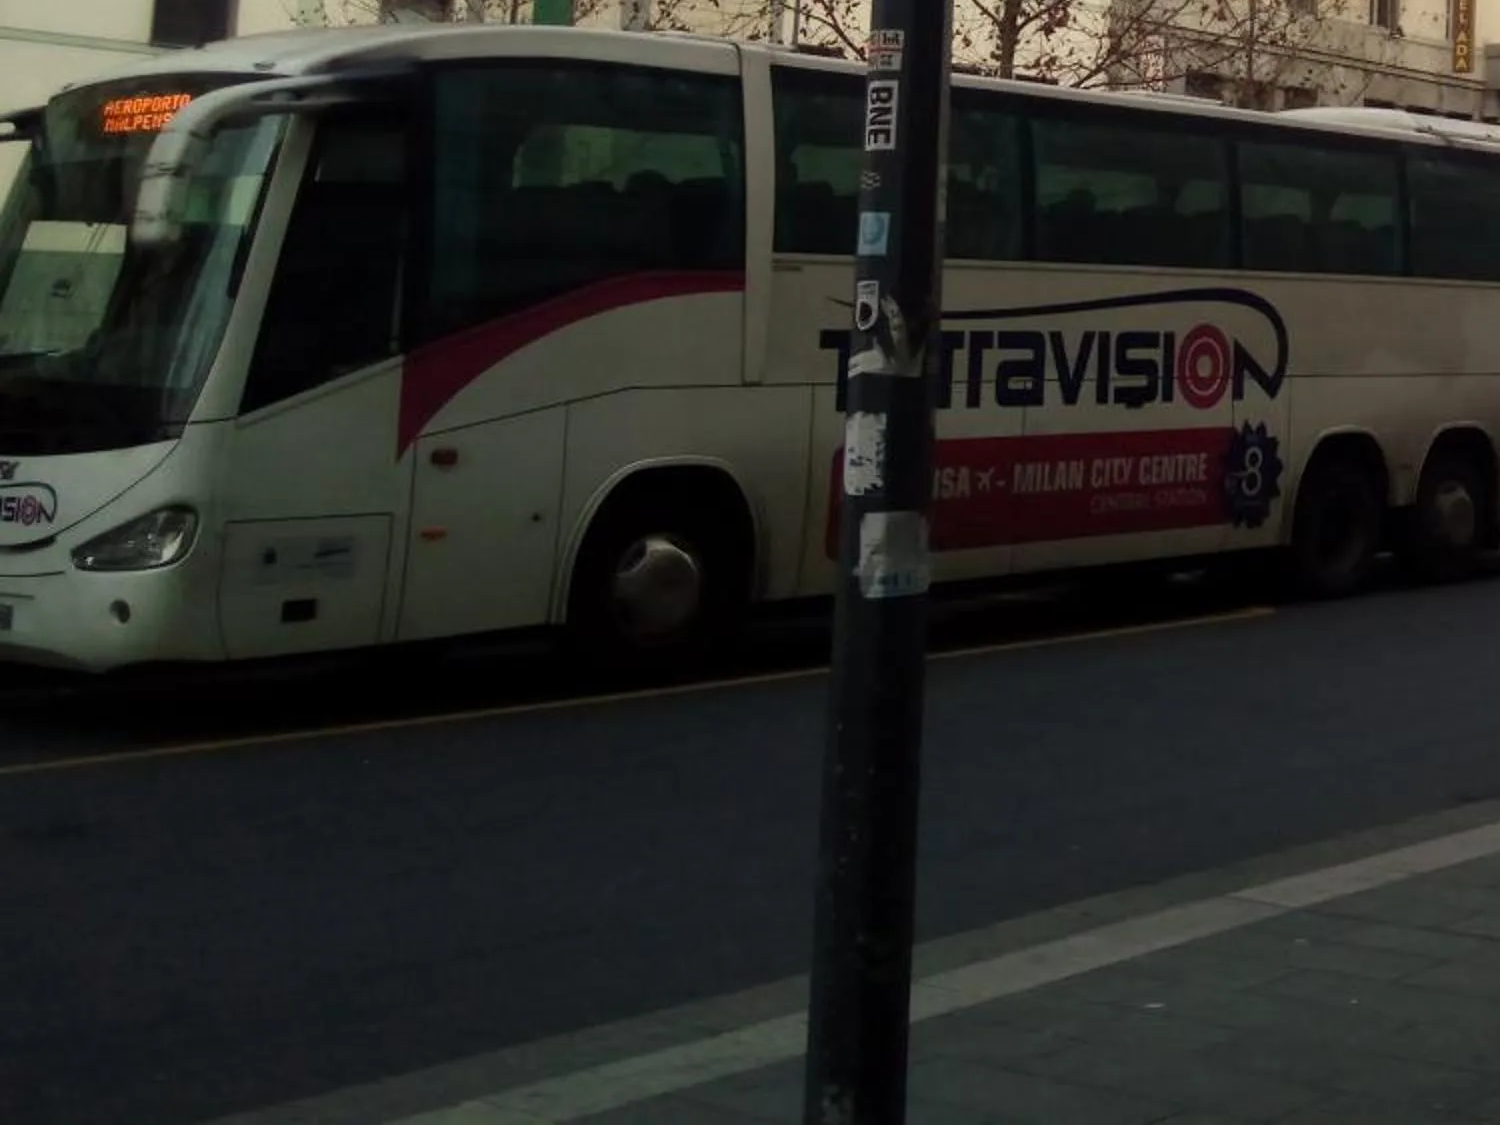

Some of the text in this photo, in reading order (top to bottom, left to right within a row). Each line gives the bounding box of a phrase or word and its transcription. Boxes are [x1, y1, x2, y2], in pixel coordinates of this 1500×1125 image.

[1456, 31, 1469, 71] ADA
[103, 94, 192, 115] AEROPORTO
[103, 112, 175, 132] MALPENS
[868, 87, 893, 146] BNE
[1011, 452, 1209, 494] MILAN CITY CENTRE
